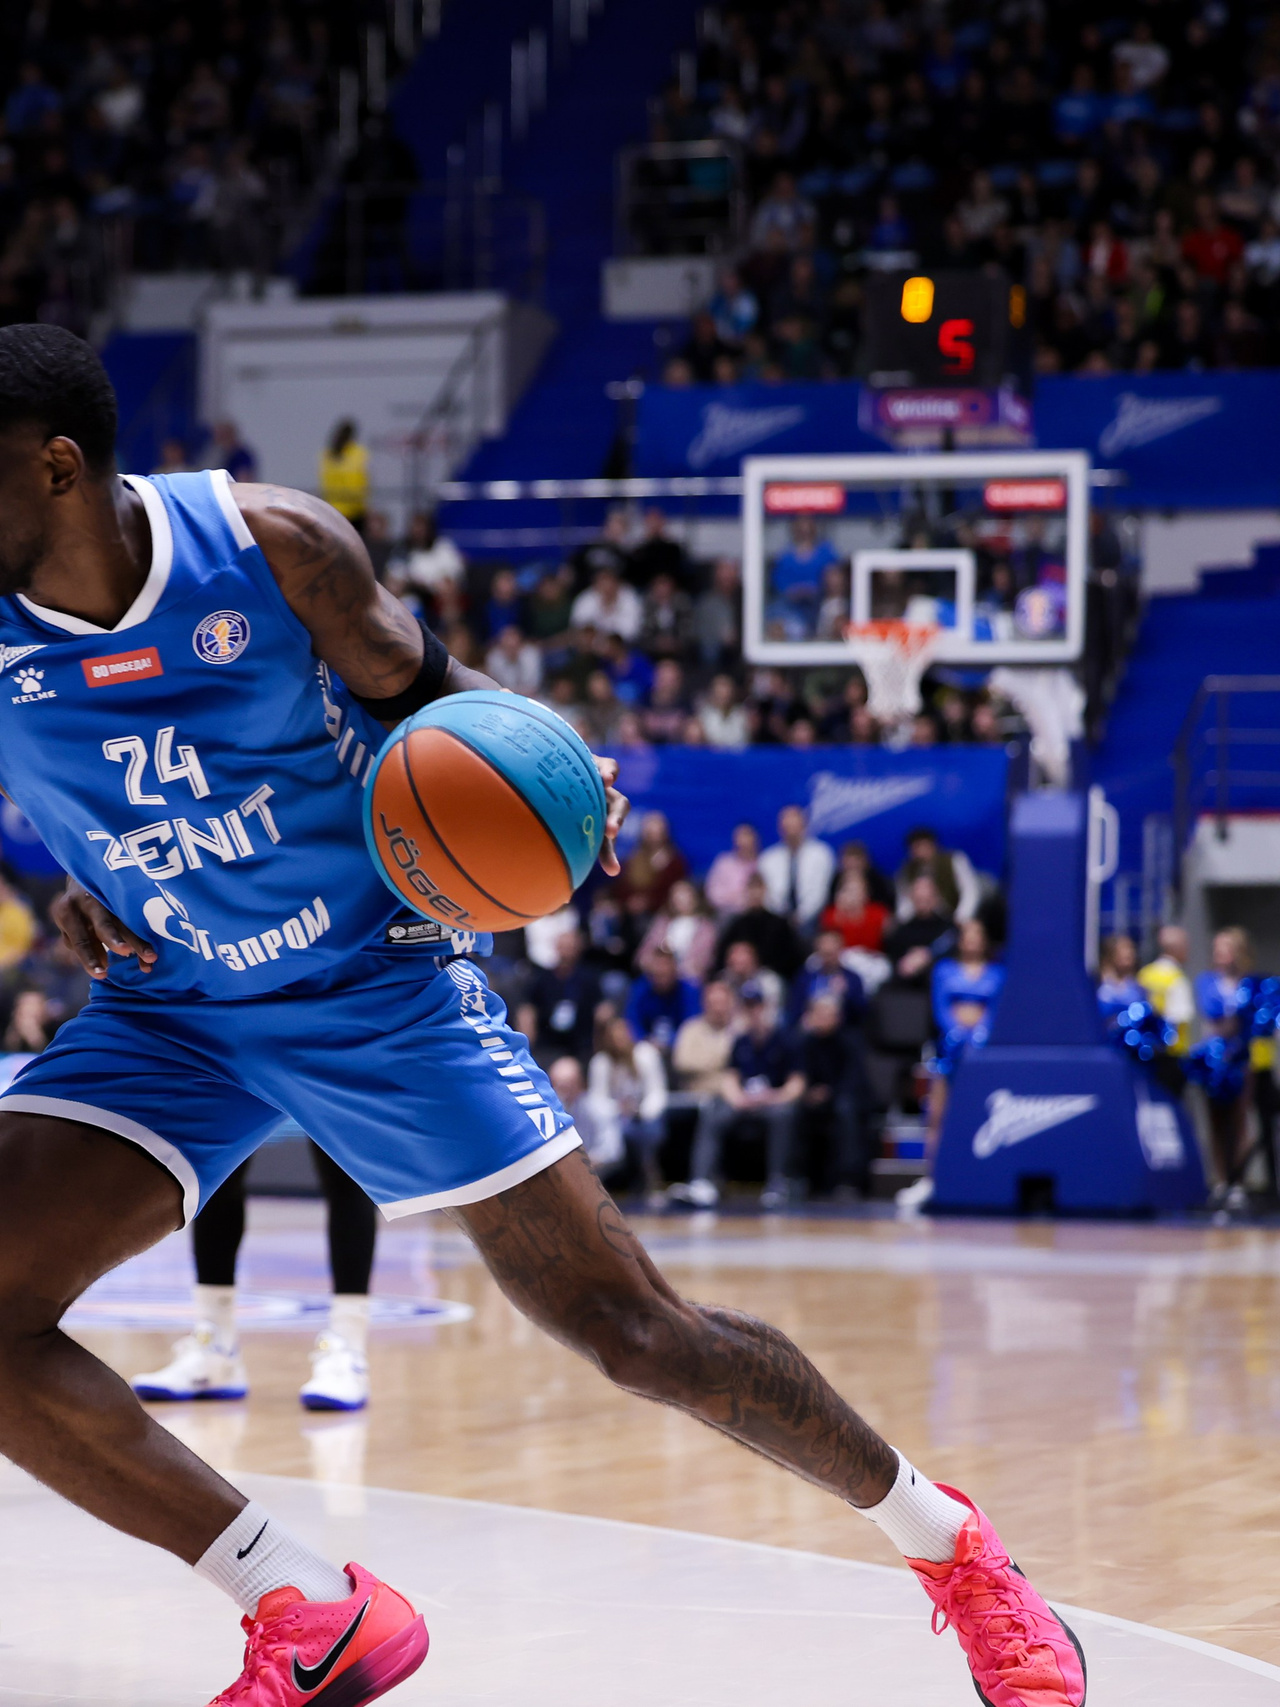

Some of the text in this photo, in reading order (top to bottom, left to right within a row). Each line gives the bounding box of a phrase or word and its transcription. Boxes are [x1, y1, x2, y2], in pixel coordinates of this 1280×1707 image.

[938, 319, 976, 375] 5
[11, 690, 57, 705] KELME
[108, 657, 153, 675] ПОБЕДА!
[102, 726, 211, 805] 24
[86, 783, 282, 880] ZENIT
[379, 812, 474, 930] JÖGEL
